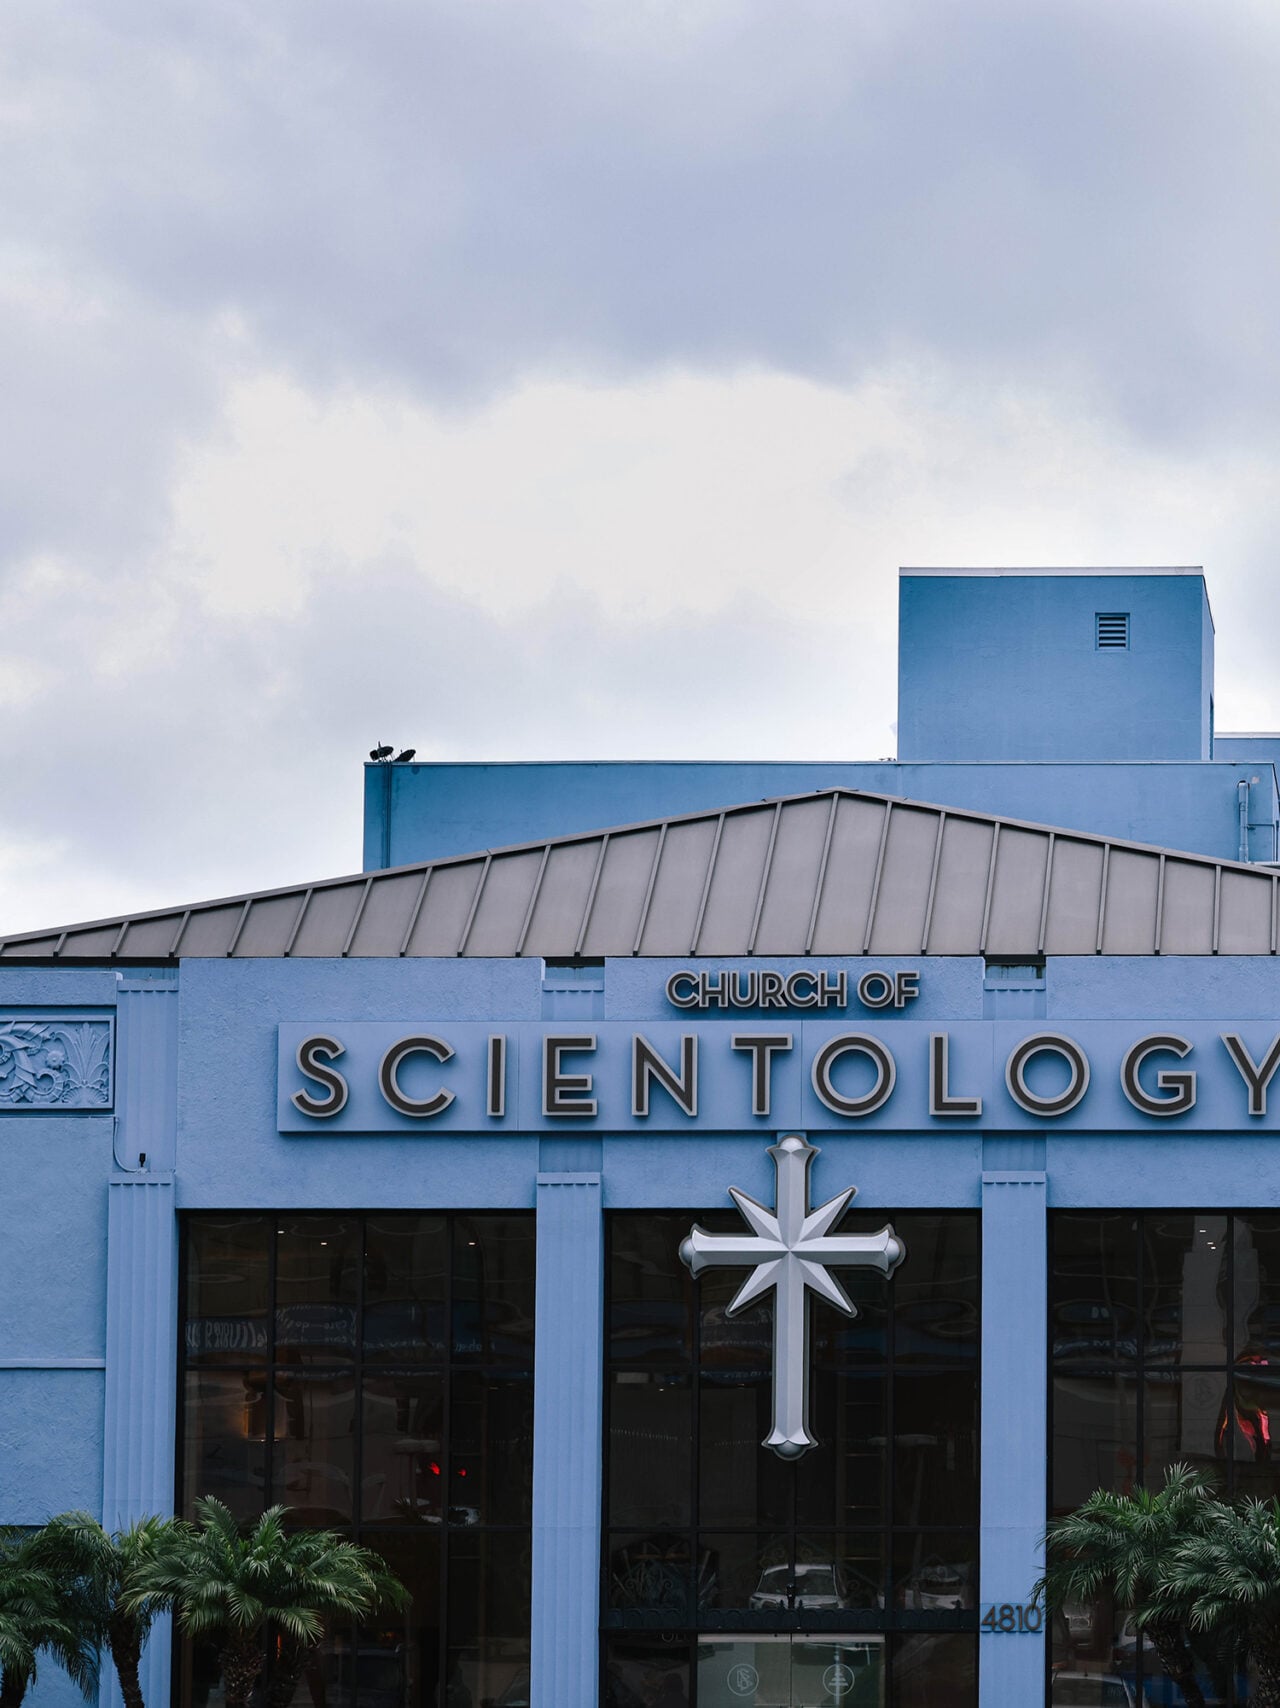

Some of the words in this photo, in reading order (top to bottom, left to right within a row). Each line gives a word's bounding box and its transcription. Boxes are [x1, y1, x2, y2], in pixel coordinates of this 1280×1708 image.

[665, 970, 848, 1008] CHURCH
[857, 970, 921, 1008] OF
[981, 1604, 1042, 1631] 4810
